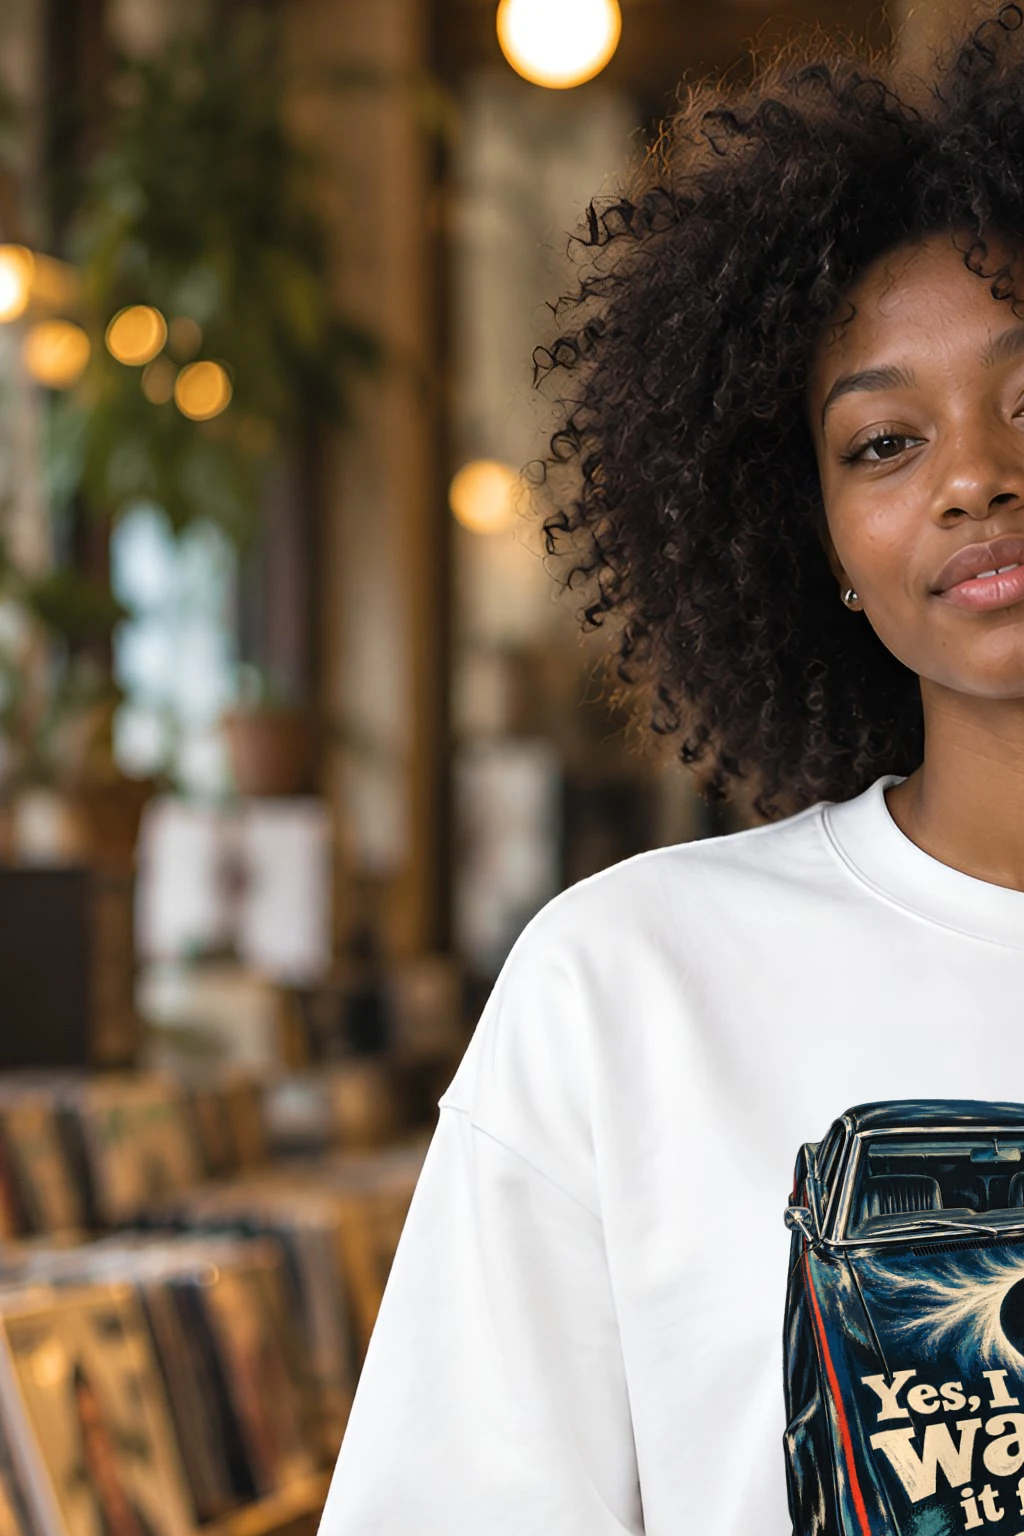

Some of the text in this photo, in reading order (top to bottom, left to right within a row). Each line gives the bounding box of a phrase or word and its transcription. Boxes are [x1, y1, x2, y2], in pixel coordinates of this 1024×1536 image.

[861, 1369, 1019, 1423] Yes, I
[960, 1486, 1004, 1530] it
